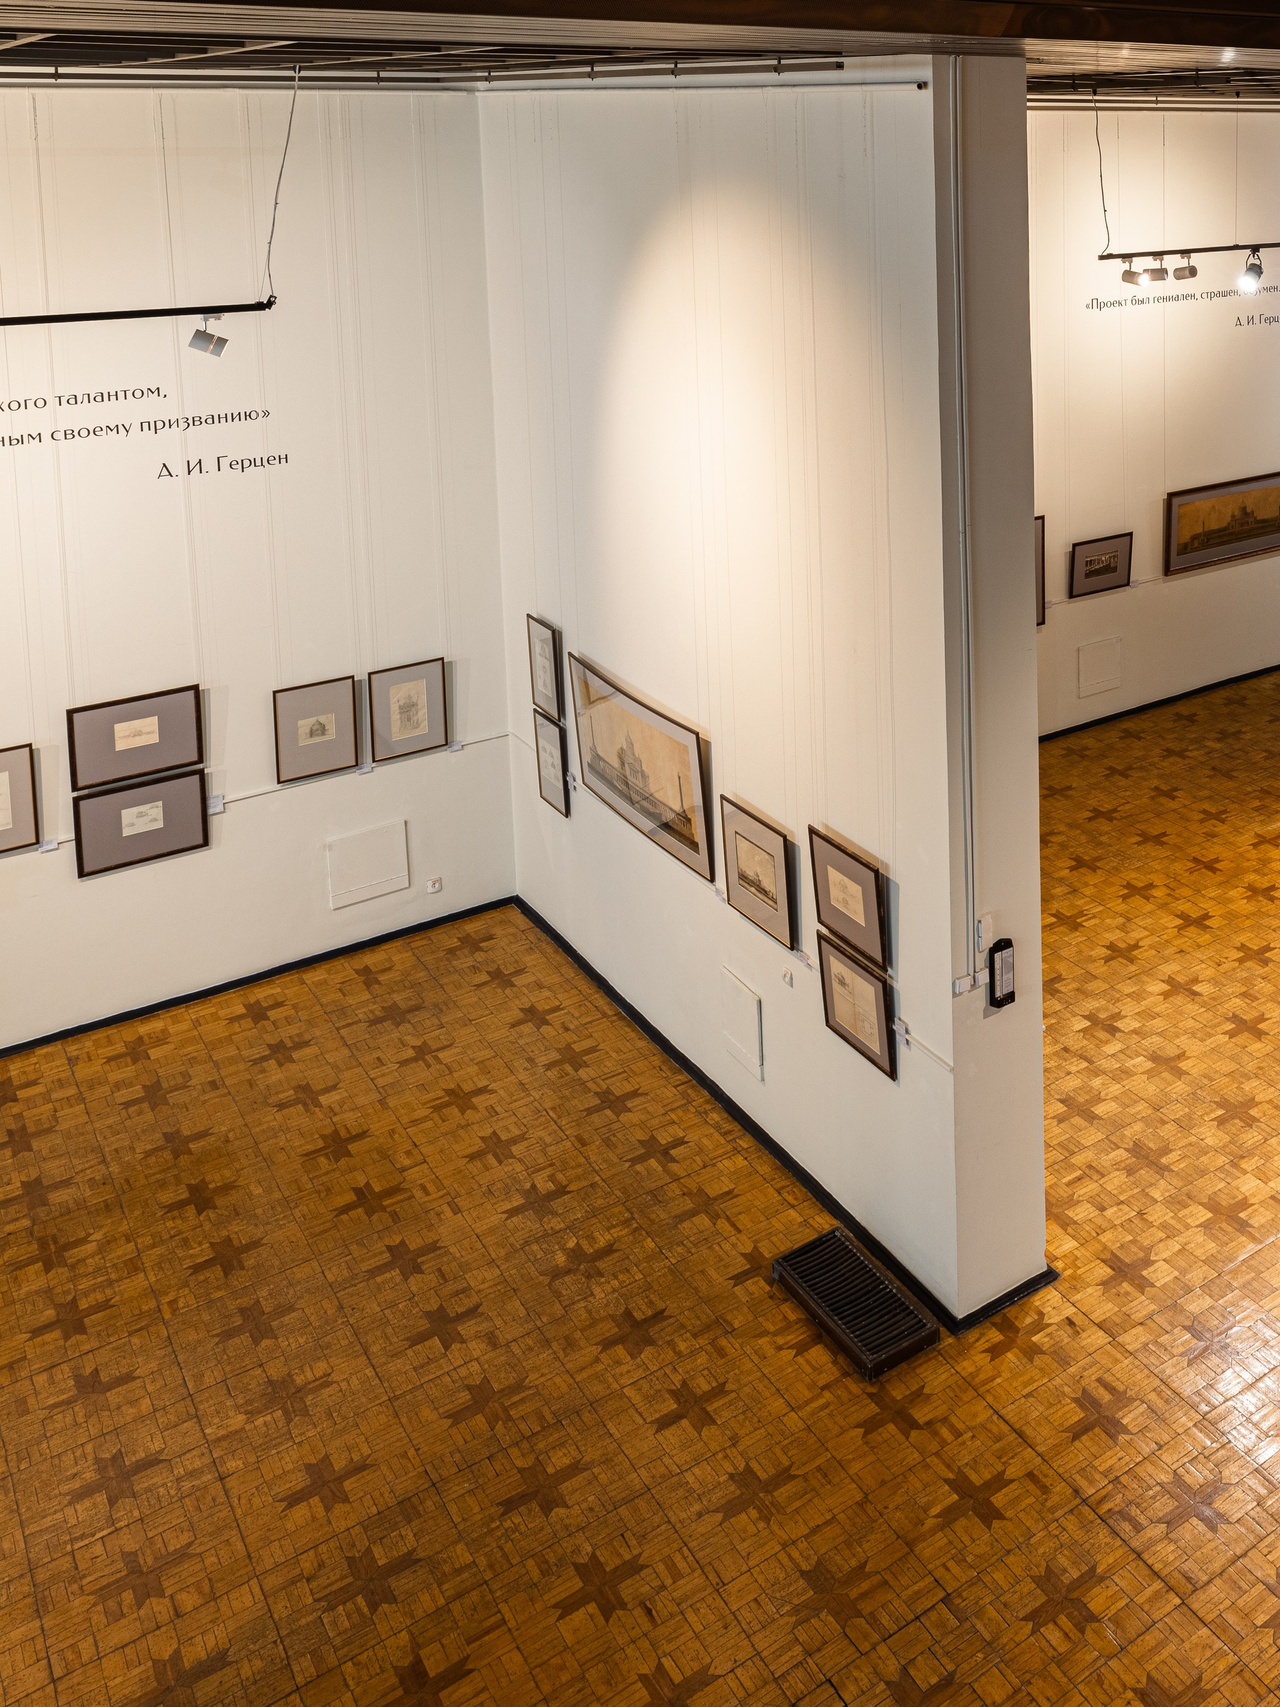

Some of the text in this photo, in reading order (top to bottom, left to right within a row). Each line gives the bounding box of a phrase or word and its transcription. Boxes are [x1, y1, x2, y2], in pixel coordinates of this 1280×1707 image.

[1085, 298, 1128, 312] «Проект
[1131, 295, 1150, 306] был
[1153, 291, 1199, 304] гениален,
[1200, 288, 1242, 301] страшен,
[1247, 314, 1257, 326] И.
[54, 386, 168, 407] талантом,
[50, 421, 132, 442] своему
[140, 408, 271, 435] призванию»
[187, 458, 209, 476] И.
[216, 453, 289, 474] Герцен
